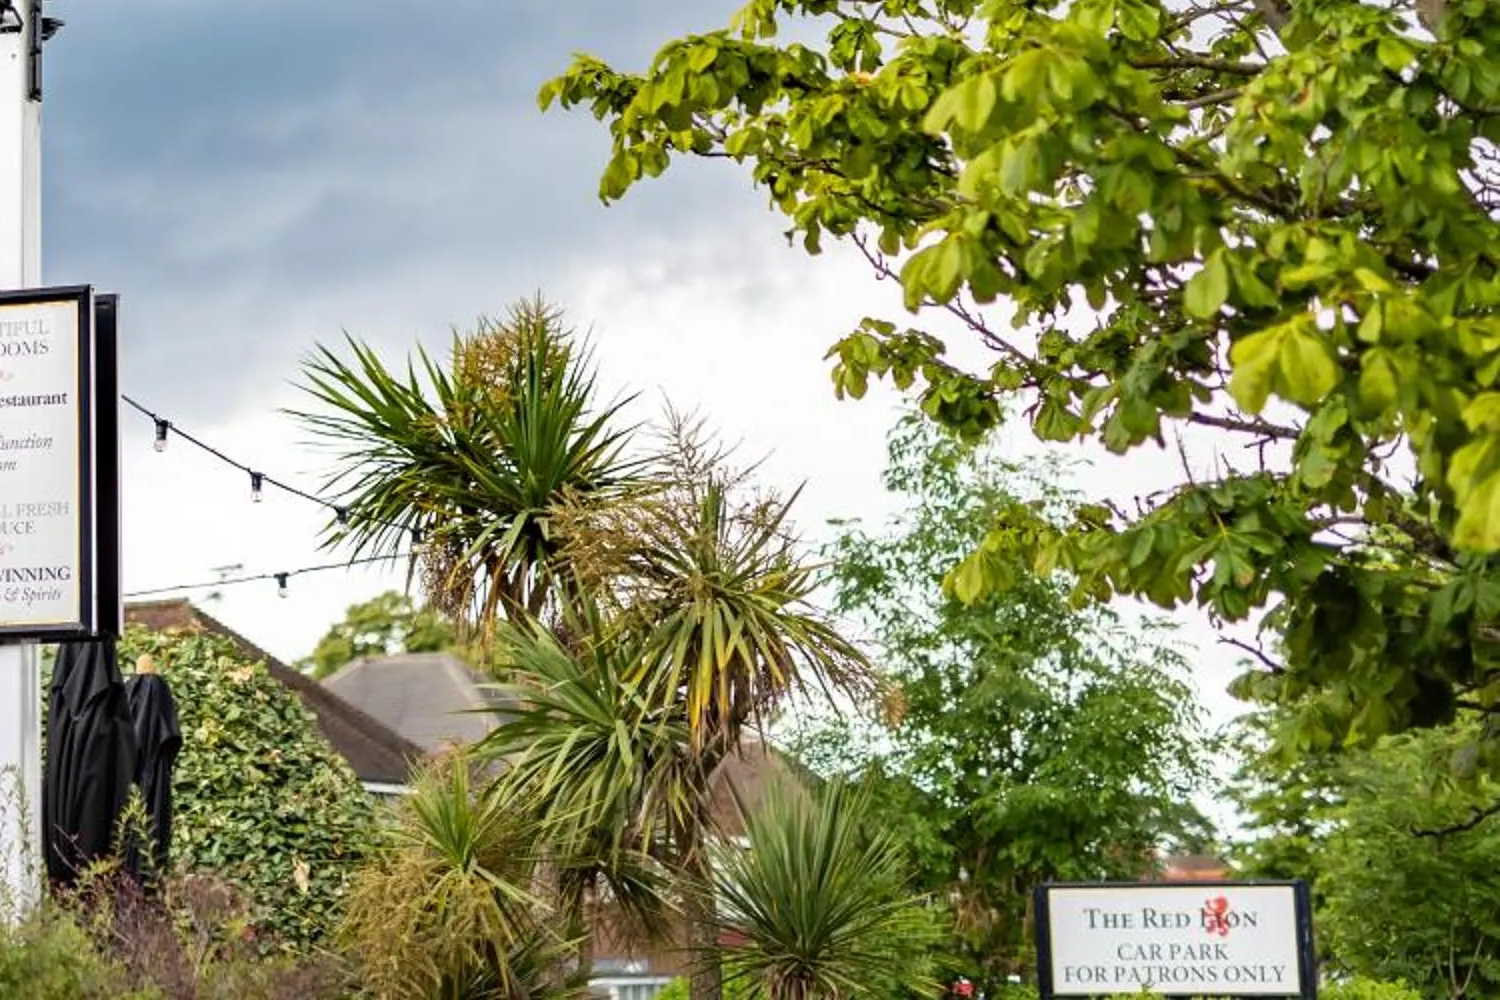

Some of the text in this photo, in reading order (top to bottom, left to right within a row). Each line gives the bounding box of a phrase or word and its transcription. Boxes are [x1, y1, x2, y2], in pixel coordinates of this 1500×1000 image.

[16, 501, 69, 518] FRESH
[4, 588, 19, 601] &
[21, 587, 62, 607] Spirits
[1117, 943, 1230, 961] CAR PARK
[1064, 965, 1286, 984] FOR PATRONS ONLY
